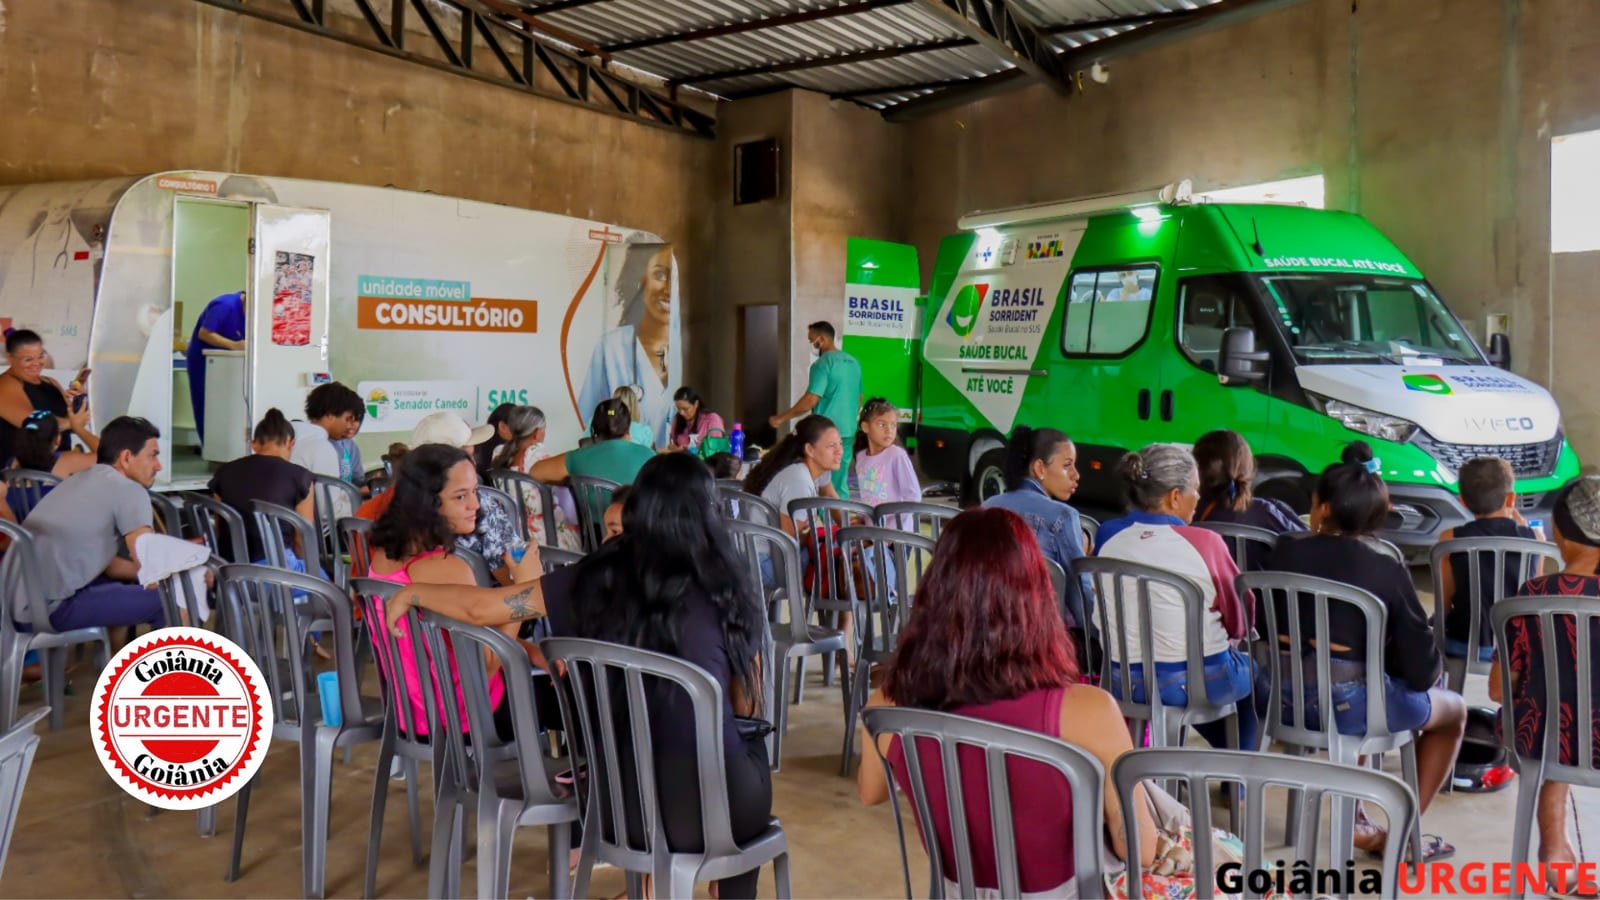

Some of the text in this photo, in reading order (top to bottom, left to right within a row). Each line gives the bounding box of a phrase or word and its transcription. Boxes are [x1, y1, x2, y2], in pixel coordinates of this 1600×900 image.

[1264, 256, 1309, 267] SAÚDE
[1309, 257, 1352, 268] BUCAL
[363, 280, 465, 299] unidade móvel
[991, 287, 1045, 307] BRASIL
[848, 296, 904, 312] BRASIL
[375, 302, 524, 328] CONSULTÓRIO
[848, 310, 904, 322] SORRIDENTE
[959, 341, 1028, 361] SAÚDE BUCAL
[966, 375, 1013, 394] ATÉ VOCÊ
[393, 398, 468, 410] Senador Canedo
[487, 388, 529, 412] SMS
[1463, 416, 1534, 431] IVECO
